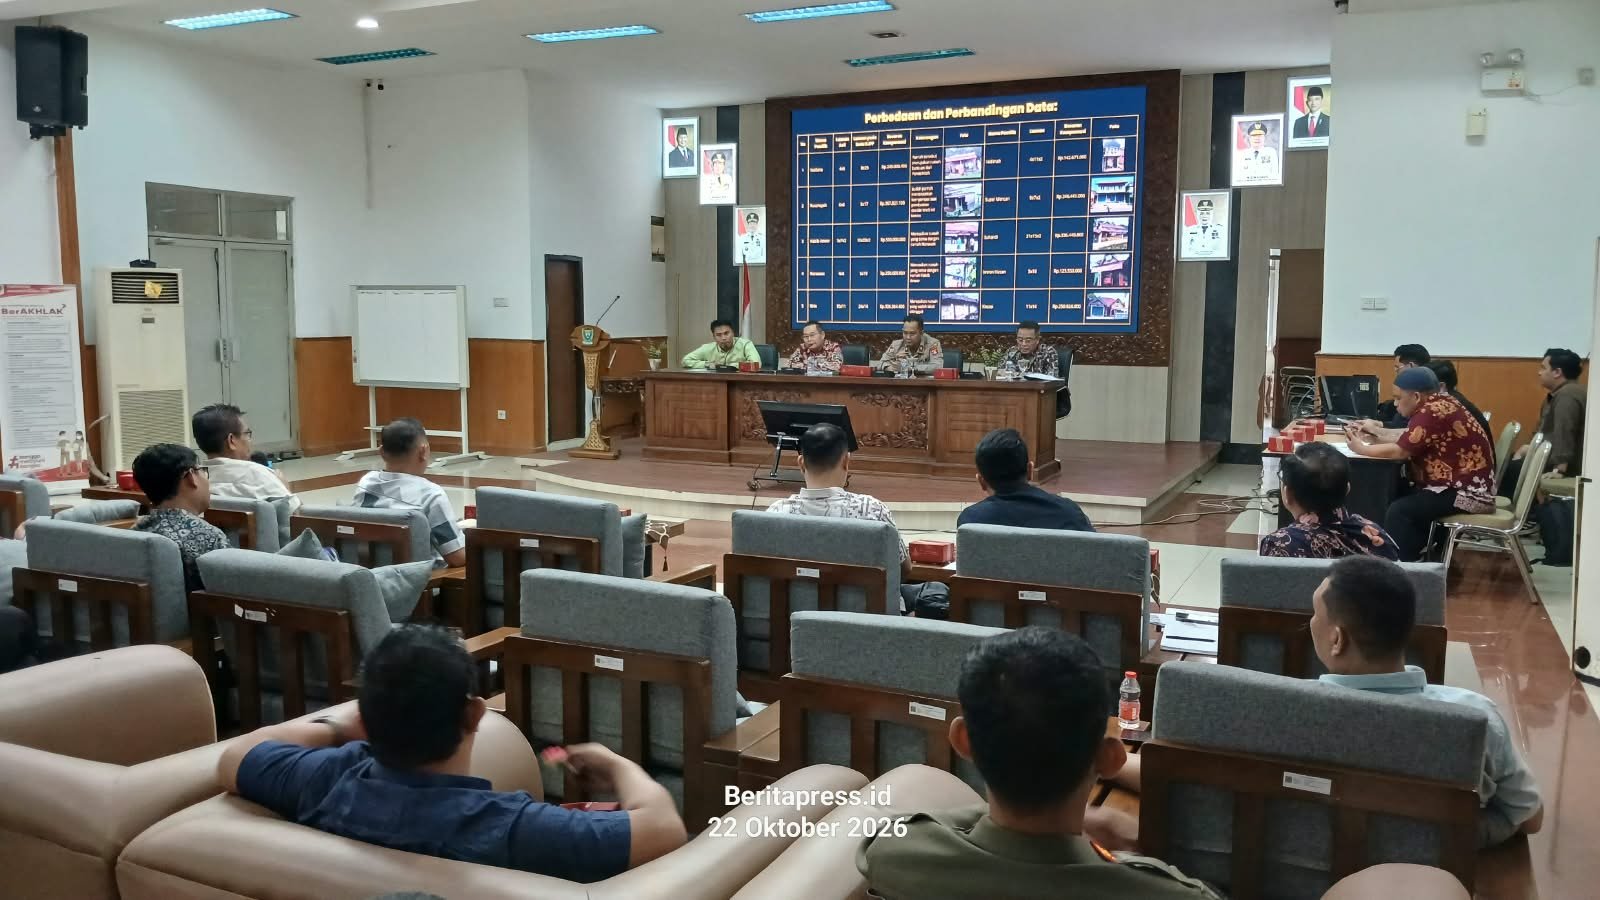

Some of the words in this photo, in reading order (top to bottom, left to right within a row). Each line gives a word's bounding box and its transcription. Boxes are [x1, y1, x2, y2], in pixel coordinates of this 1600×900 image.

[864, 112, 922, 124] Perbedaan
[923, 109, 944, 121] dan
[945, 104, 1025, 119] Perbandingan
[1026, 102, 1058, 114] Data:
